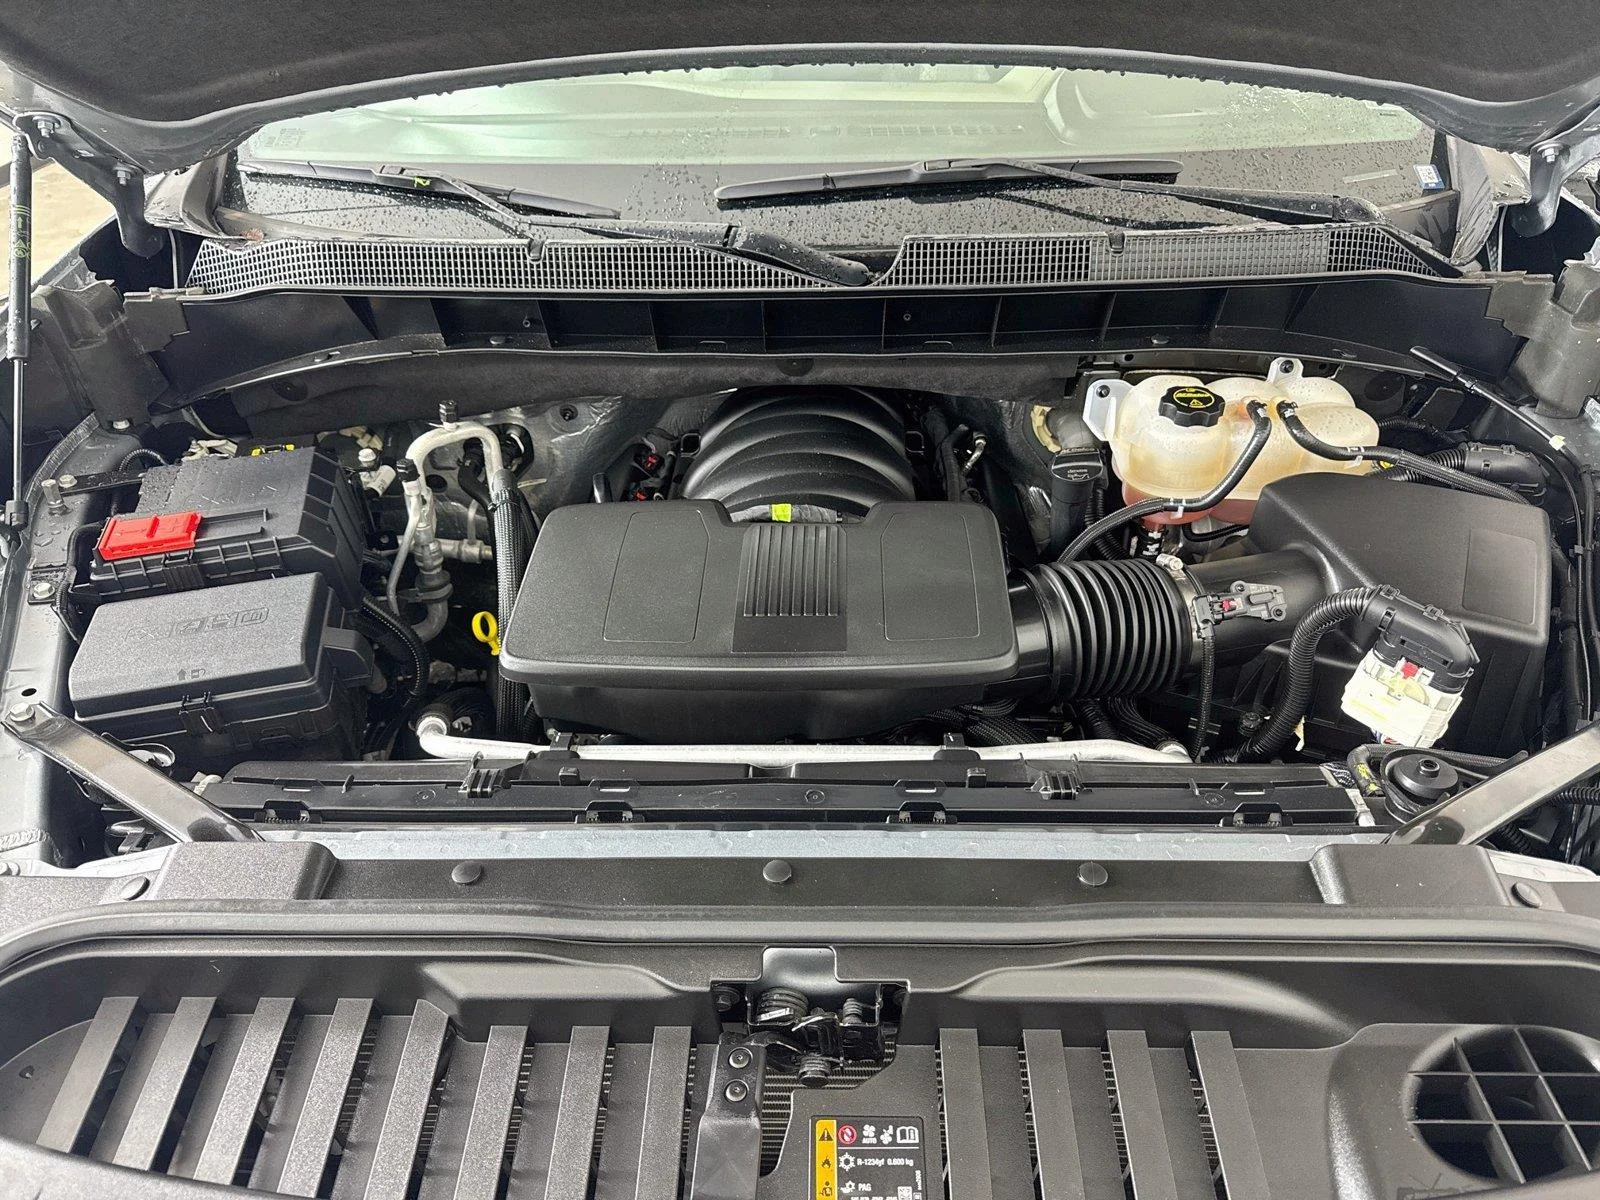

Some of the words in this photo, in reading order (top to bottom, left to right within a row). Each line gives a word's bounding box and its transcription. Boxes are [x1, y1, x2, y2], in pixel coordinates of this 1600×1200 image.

[856, 1158, 885, 1167] R-1234yf
[905, 1158, 914, 1167] kg
[858, 1183, 872, 1191] PAG
